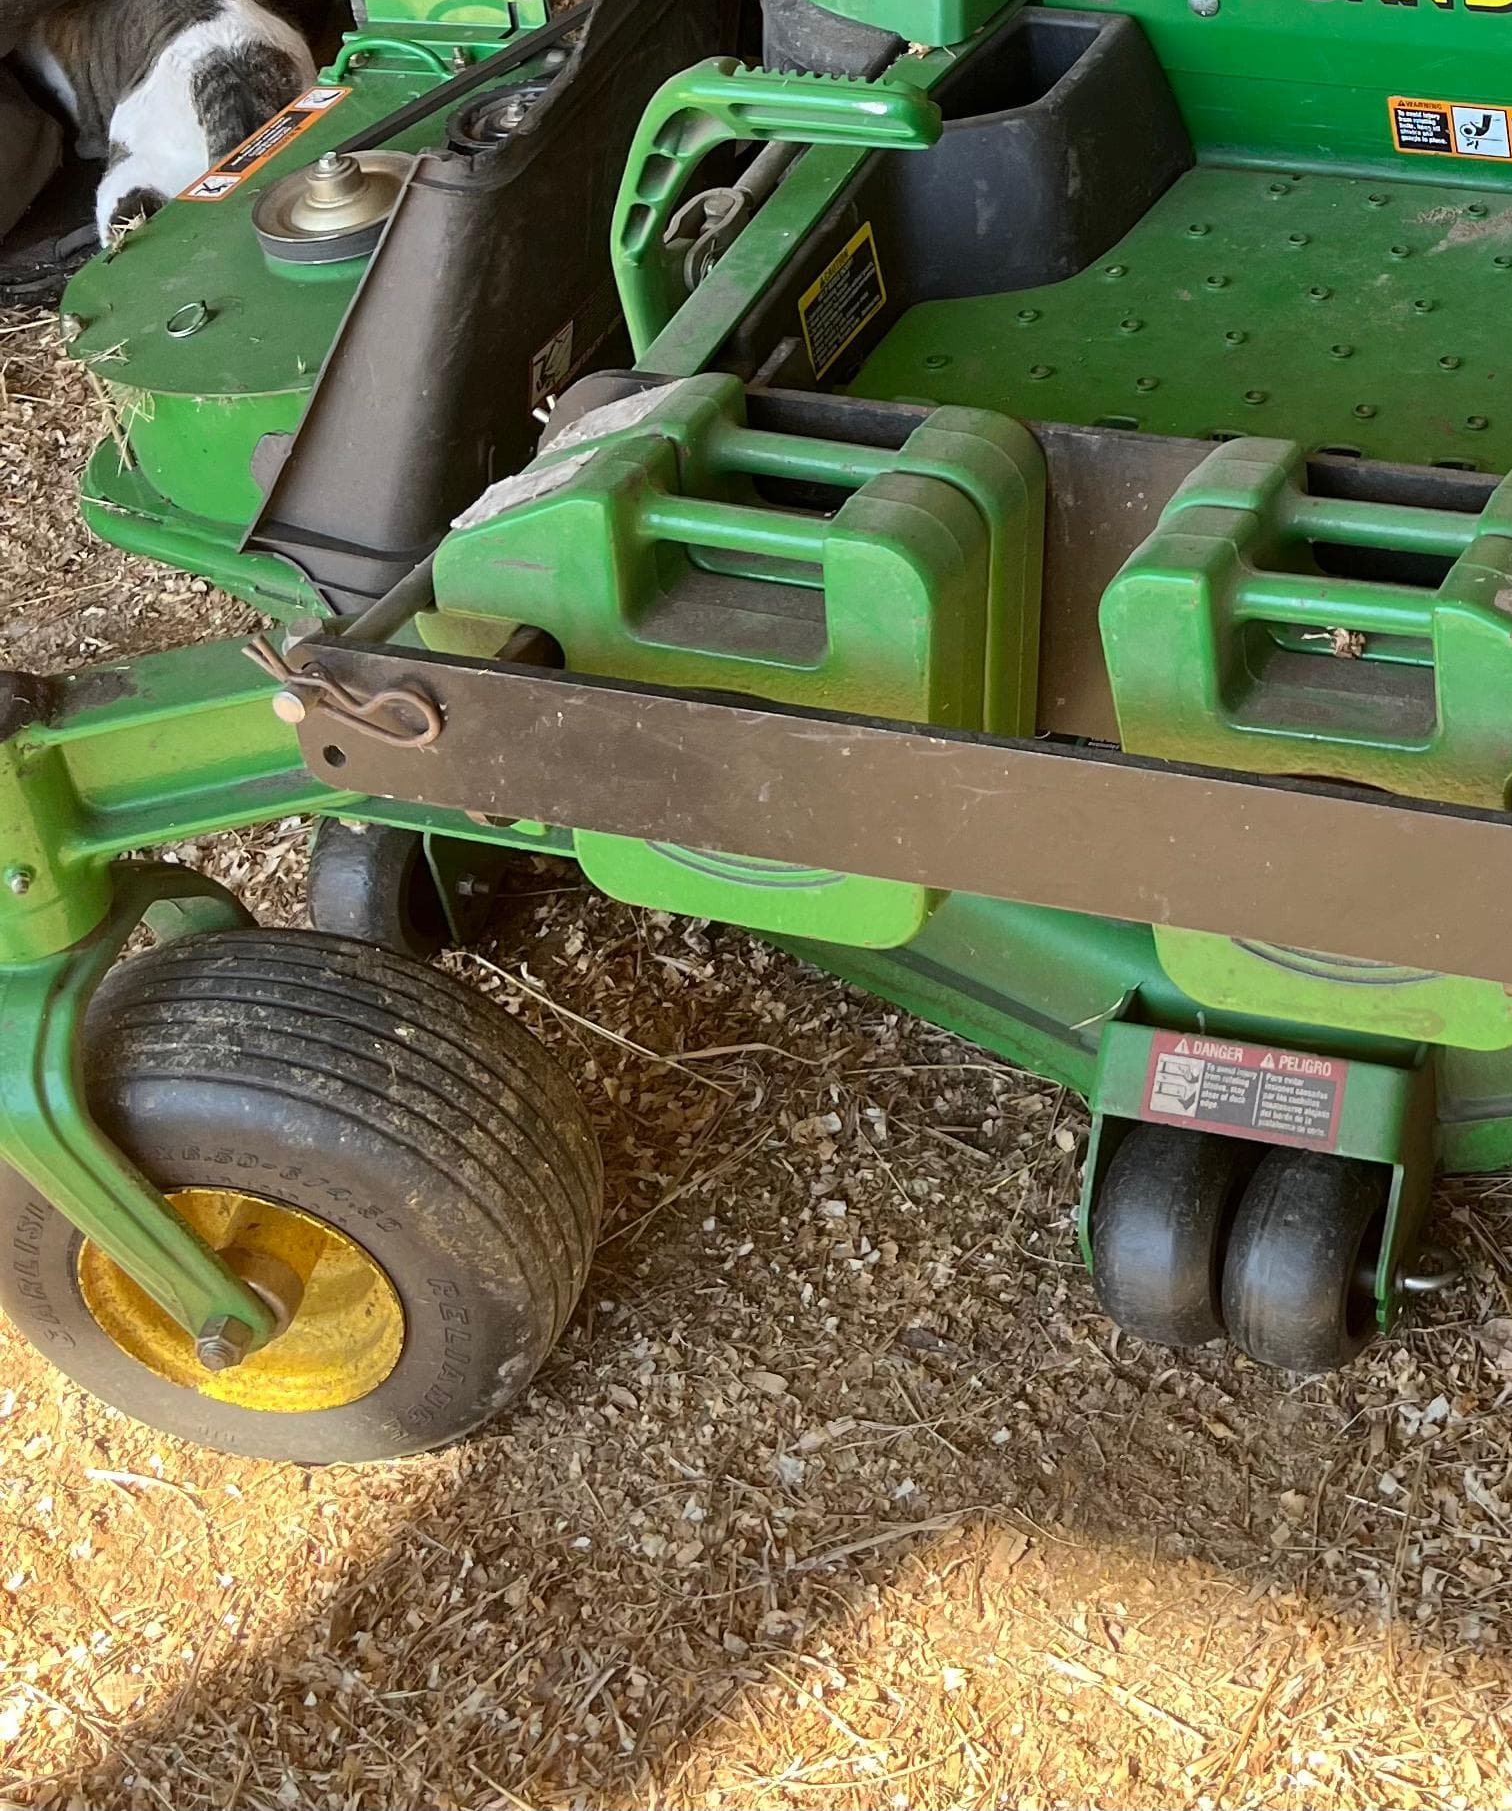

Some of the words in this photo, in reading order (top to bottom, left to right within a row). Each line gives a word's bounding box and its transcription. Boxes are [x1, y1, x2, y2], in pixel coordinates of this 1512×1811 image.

[1406, 101, 1442, 109] WARNING
[1193, 1040, 1243, 1061] DANGER
[1279, 1055, 1332, 1077] PELIGRO
